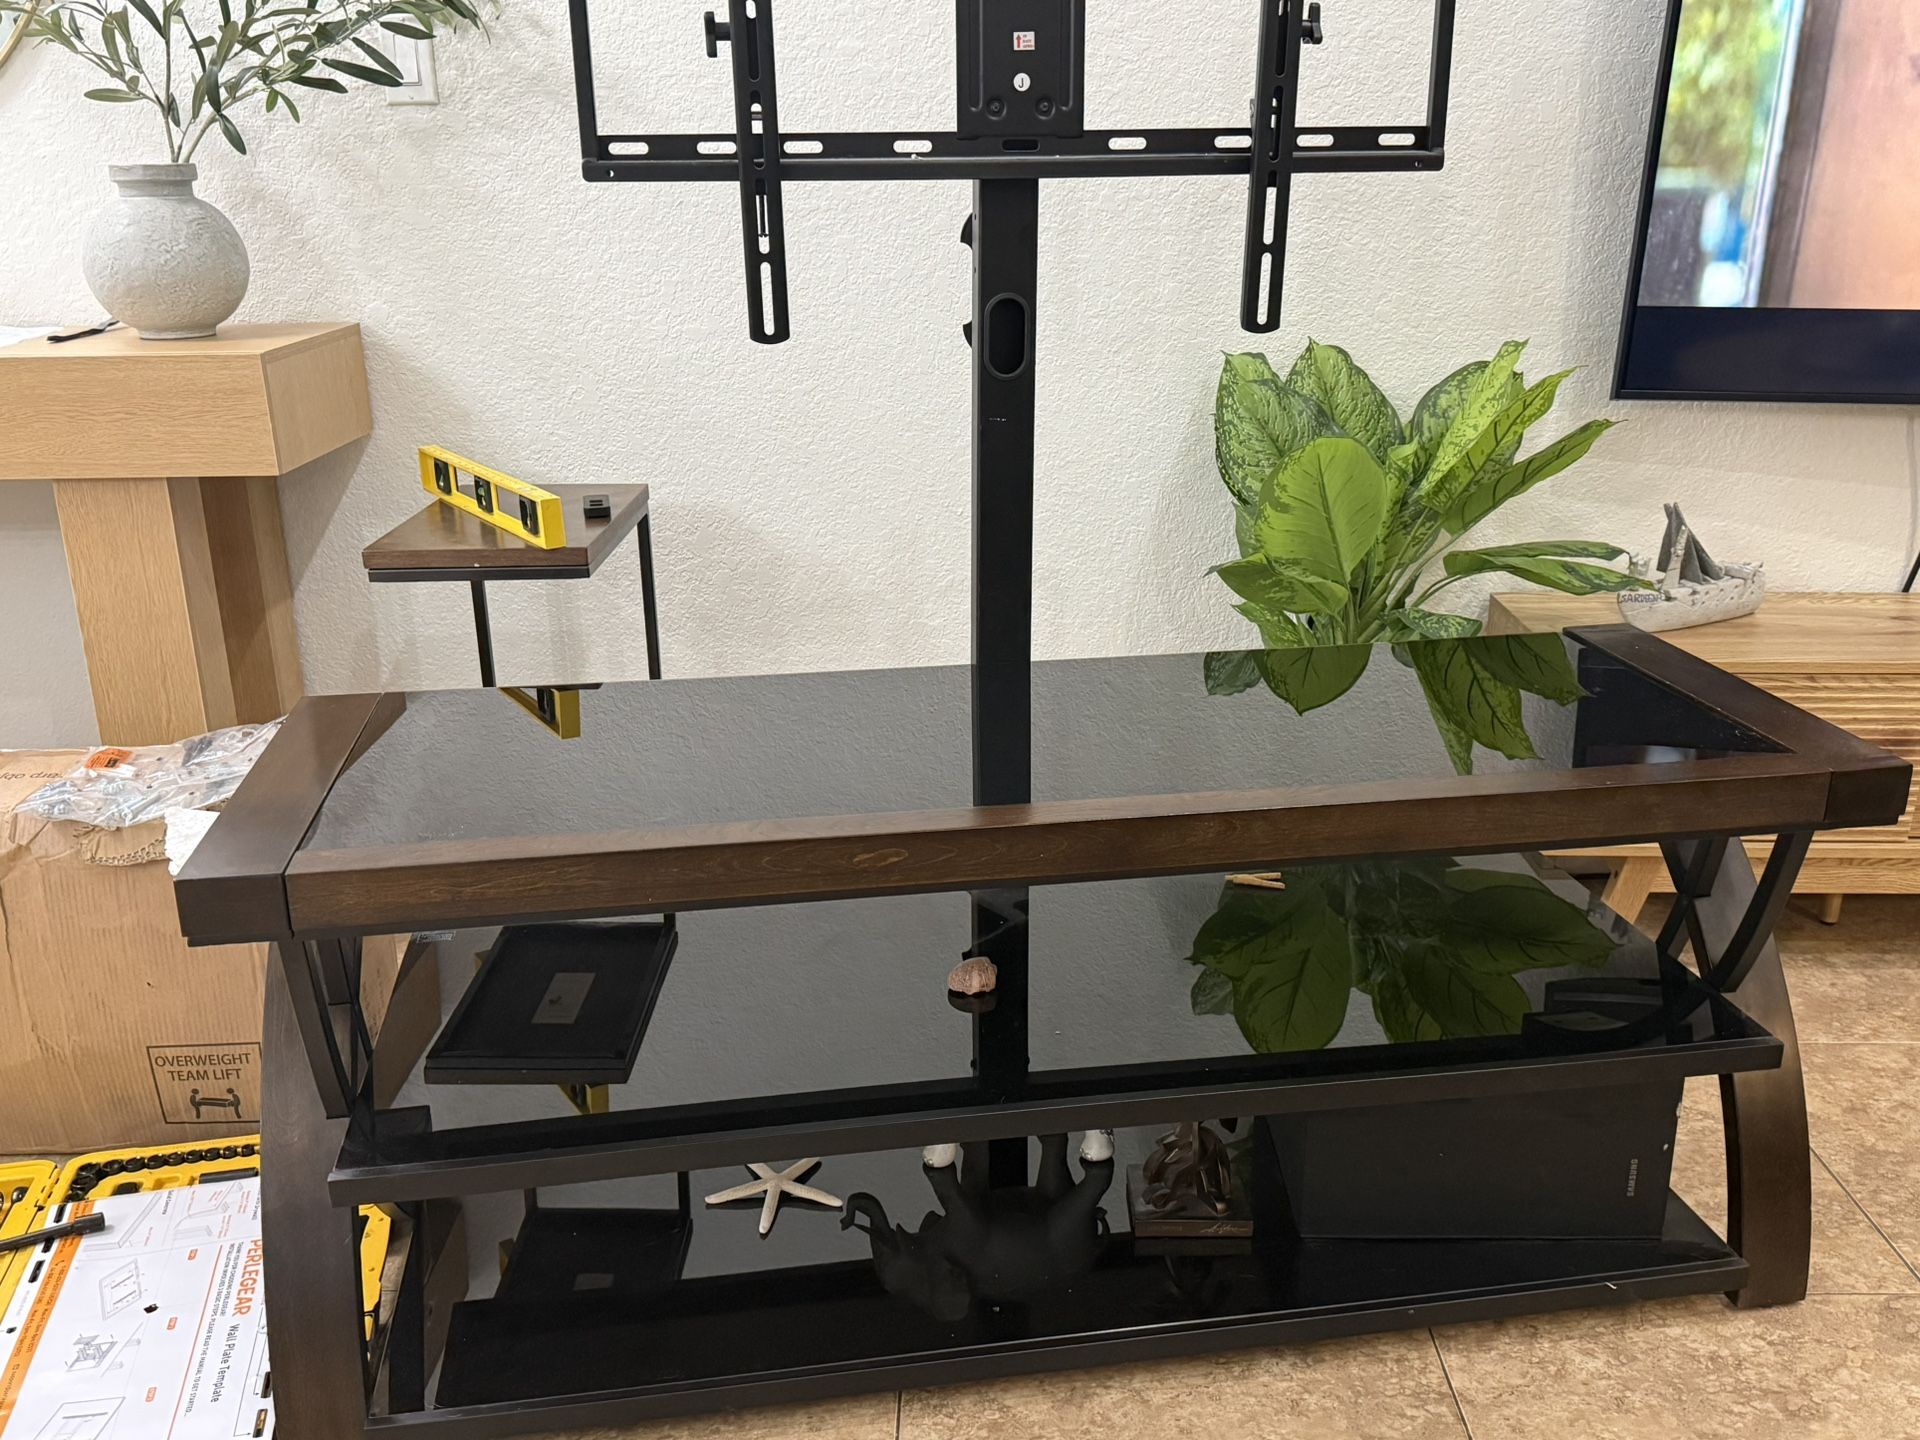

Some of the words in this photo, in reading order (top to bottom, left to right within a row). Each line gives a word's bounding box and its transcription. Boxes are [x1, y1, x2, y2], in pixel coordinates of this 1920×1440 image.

[154, 1053, 251, 1068] OVERWEIGHT
[167, 1069, 210, 1082] TEAM
[213, 1068, 242, 1081] LIFT
[1626, 1158, 1639, 1197] SAMSUNG
[232, 1239, 263, 1317] PERLEGEAR
[225, 1323, 240, 1343] Wall
[220, 1343, 236, 1365] Plate
[210, 1365, 230, 1403] Template
